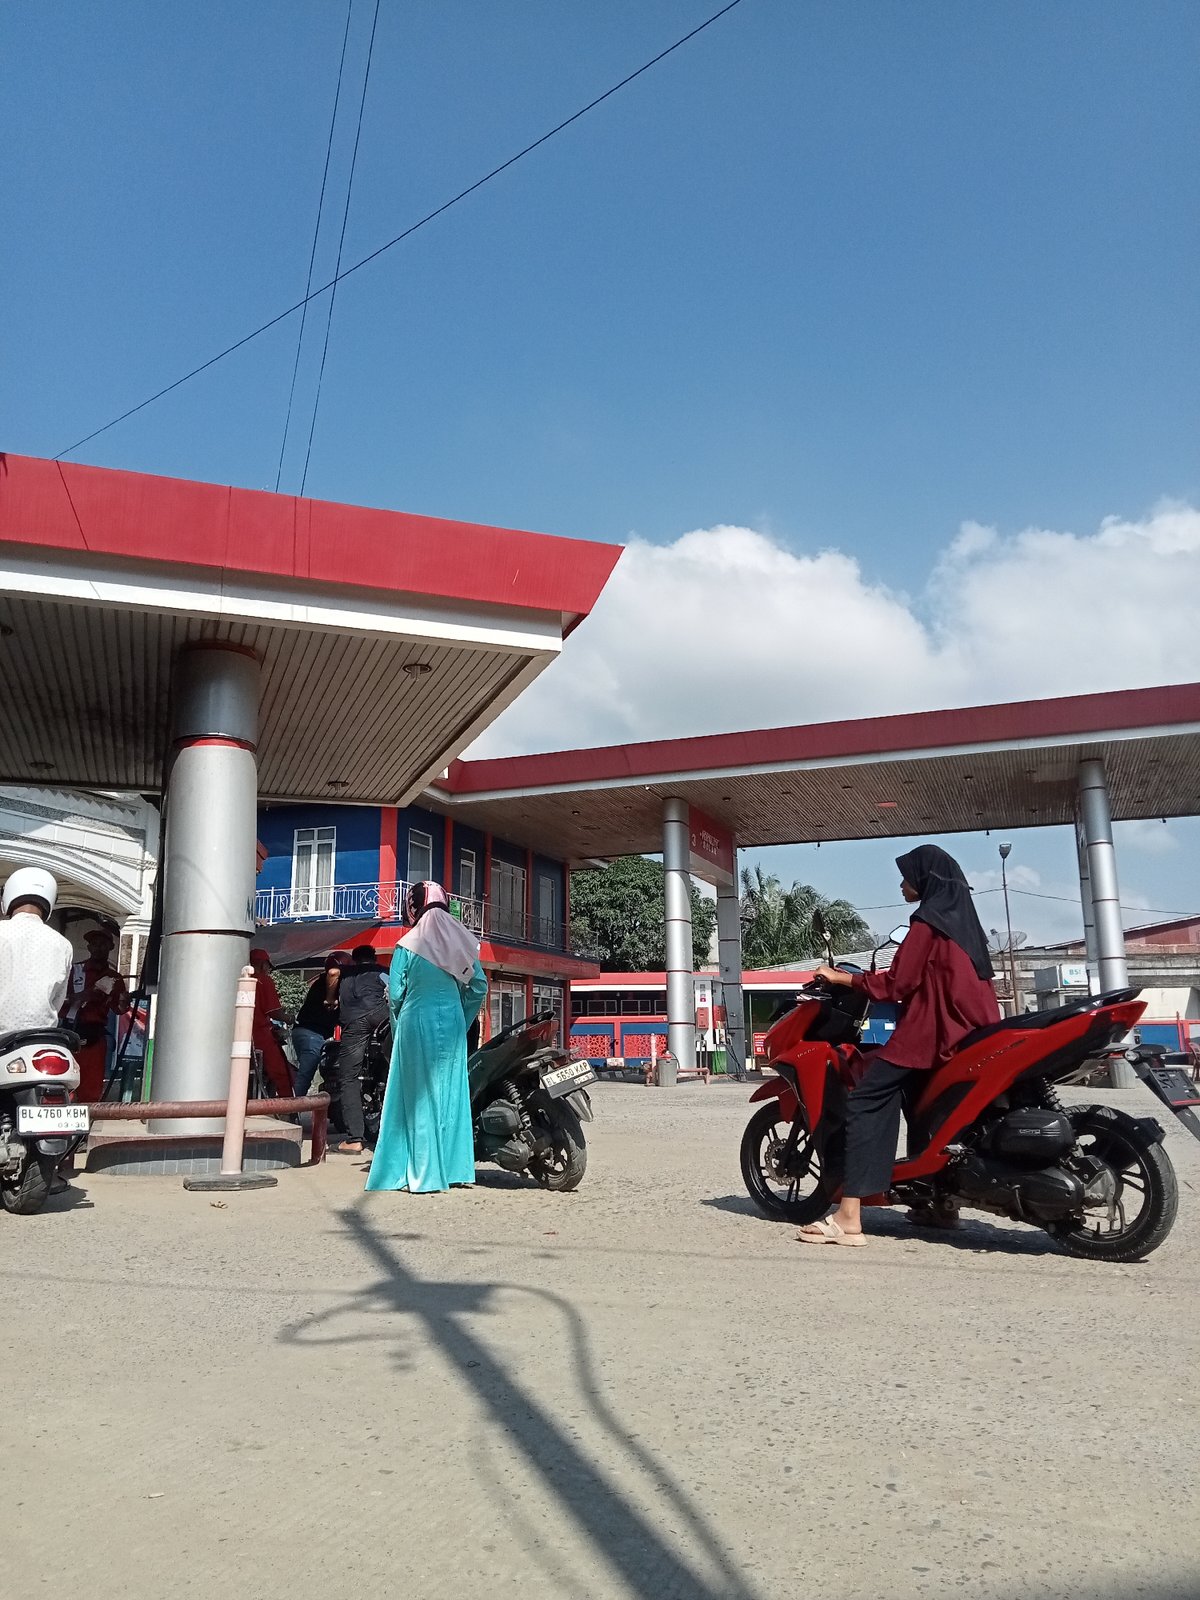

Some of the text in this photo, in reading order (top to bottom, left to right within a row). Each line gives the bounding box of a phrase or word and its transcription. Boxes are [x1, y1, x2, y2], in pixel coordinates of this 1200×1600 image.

[546, 1076, 556, 1088] BL
[556, 1069, 574, 1082] 5650
[21, 1108, 87, 1119] BL 4760 KBM
